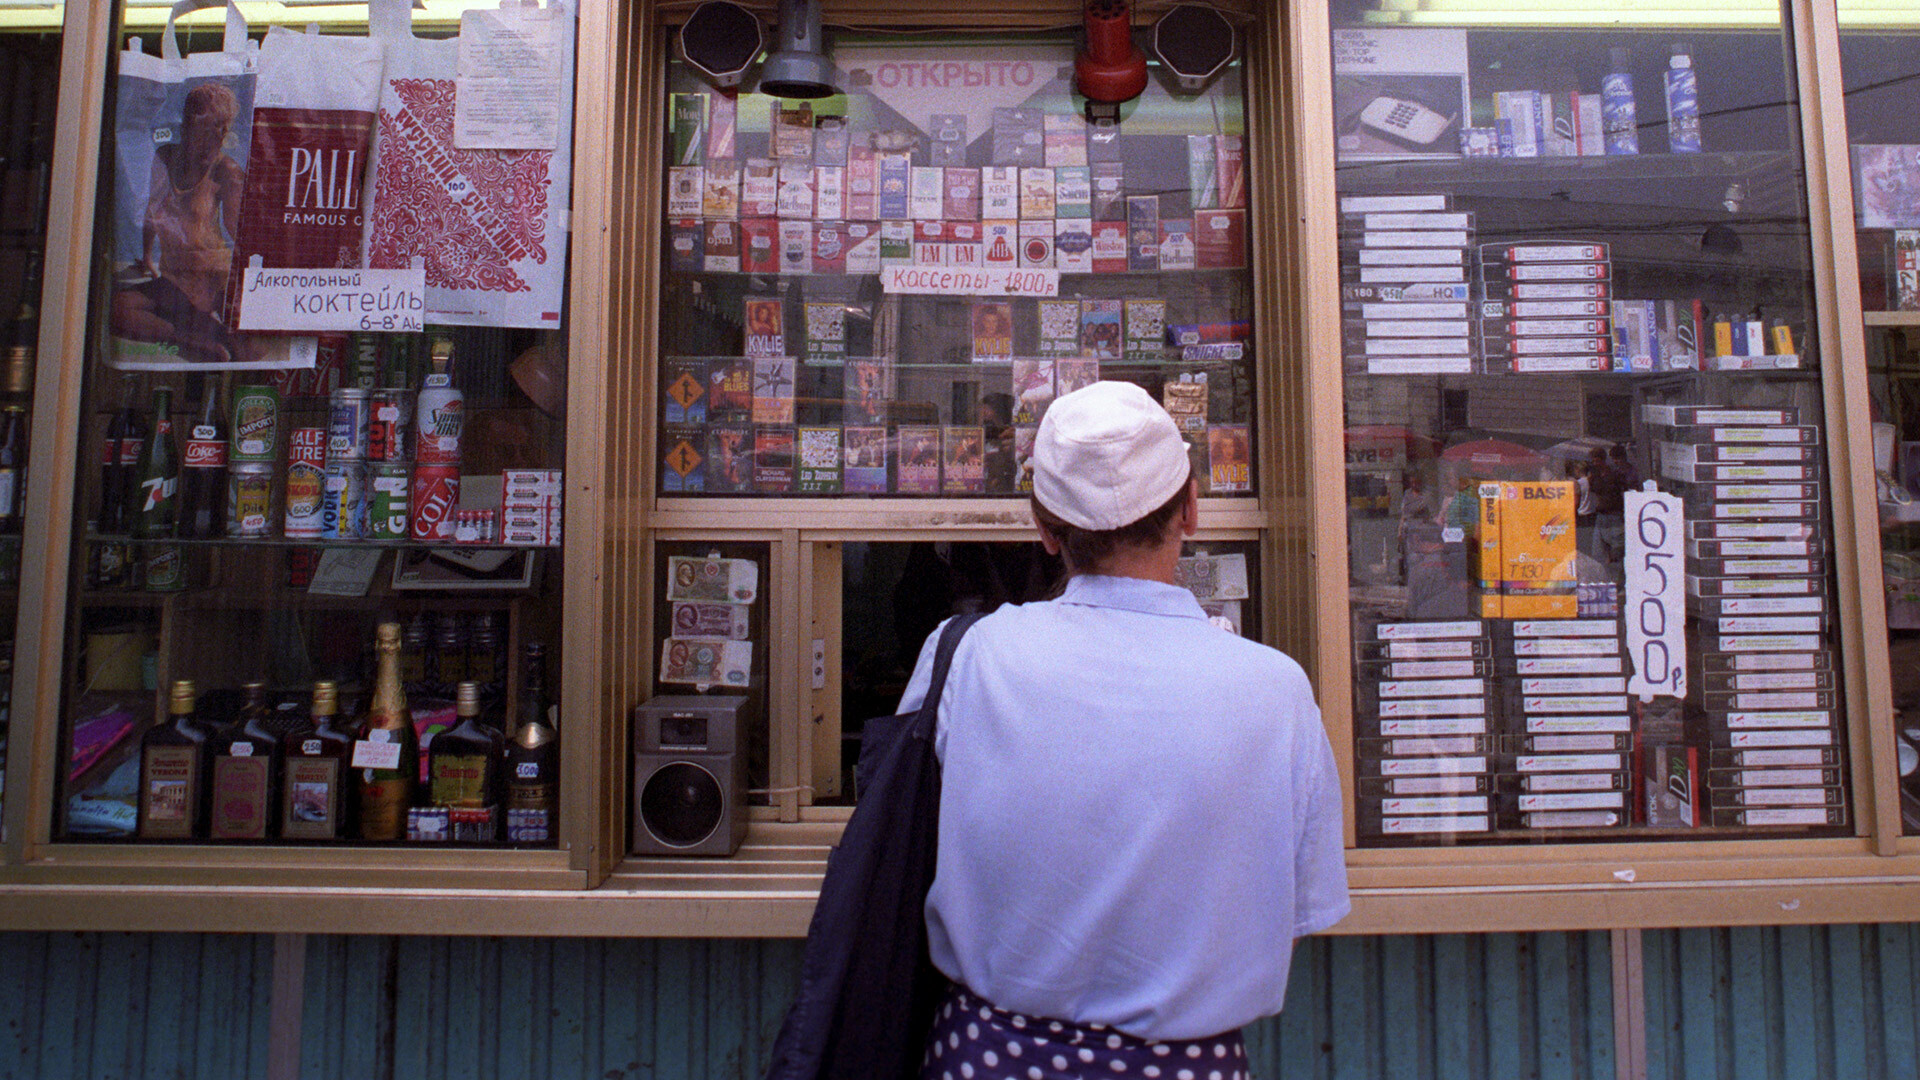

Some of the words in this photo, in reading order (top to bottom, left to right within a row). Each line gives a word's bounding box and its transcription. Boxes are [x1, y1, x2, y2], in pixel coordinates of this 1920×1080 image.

[877, 61, 1035, 88] ОТКРЫТО
[284, 147, 360, 210] PALL
[448, 182, 466, 191] 100
[988, 185, 1011, 193] KENT
[283, 213, 347, 226] FAMOUS
[249, 271, 361, 292] Алкогольный
[1433, 287, 1454, 299] HQ
[1647, 302, 1657, 339] SONY
[748, 335, 782, 353] KYLIE
[974, 337, 1011, 355] KYLIE
[723, 381, 750, 393] BLUES
[238, 417, 274, 436] IMPORT
[186, 443, 222, 462] Coke
[1211, 463, 1248, 484] KYLIE
[1523, 486, 1566, 500] BASF
[241, 502, 265, 516] Pils
[323, 489, 338, 533] VODK
[387, 476, 408, 535] GIN
[415, 477, 459, 538] COLA
[1485, 498, 1495, 526] BASF
[1521, 564, 1544, 579] 130
[1637, 499, 1675, 684] 6500
